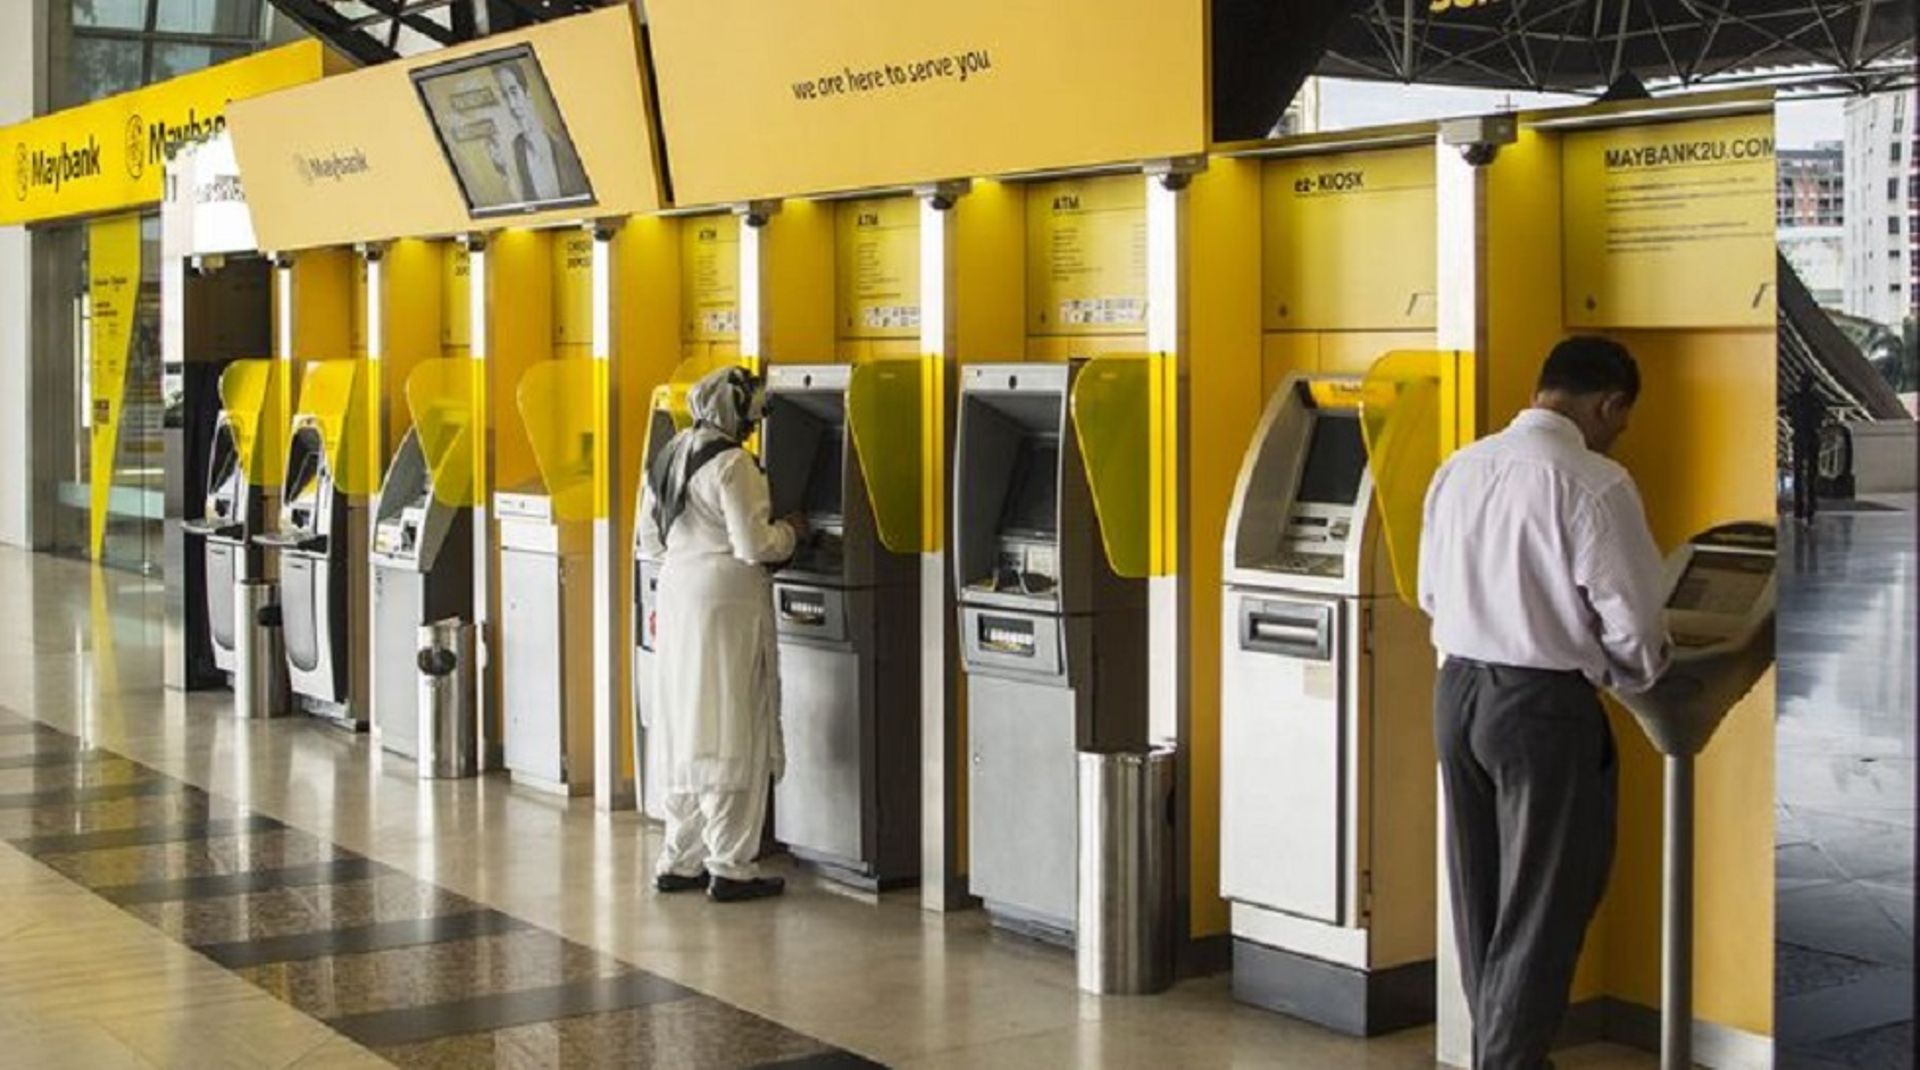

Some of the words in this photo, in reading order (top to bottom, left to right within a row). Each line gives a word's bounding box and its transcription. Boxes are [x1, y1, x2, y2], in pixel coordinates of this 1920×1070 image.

[793, 80, 817, 100] we
[818, 75, 844, 96] are
[844, 66, 885, 92] here
[885, 63, 908, 85] to
[908, 56, 954, 83] serve
[954, 49, 991, 82] you
[149, 106, 227, 166] Mayban
[1605, 136, 1776, 168] MAYBANK2U.COM
[31, 133, 101, 193] Maybank
[858, 213, 879, 226] ATM
[1053, 195, 1080, 210] ATM
